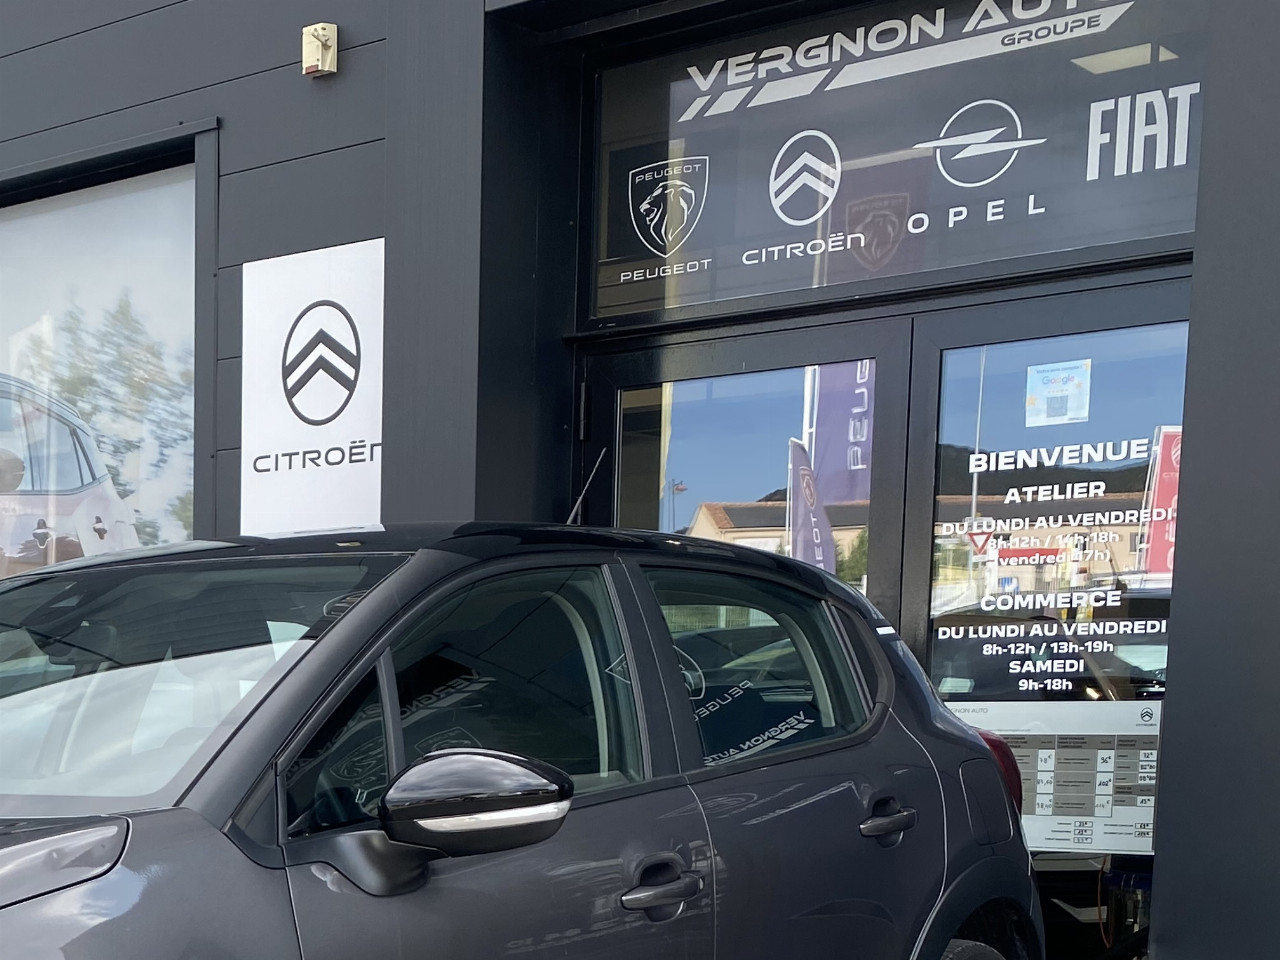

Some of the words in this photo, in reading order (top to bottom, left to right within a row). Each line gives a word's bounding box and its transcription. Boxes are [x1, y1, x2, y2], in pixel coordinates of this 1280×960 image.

[1001, 14, 1102, 47] GROUPE
[686, 8, 946, 92] VERGNON
[1086, 82, 1201, 181] FIAT
[635, 164, 702, 184] PEUGEOT
[907, 194, 1046, 234] OPEL
[620, 258, 713, 283] PEUGEOT
[969, 438, 1150, 473] BIENVENUE
[1004, 481, 1106, 504] ATELIER
[941, 522, 968, 535] DU
[972, 514, 1029, 533] LUNDI
[1034, 514, 1062, 530] AU
[1068, 507, 1176, 528] VENDREDI
[980, 590, 1122, 612] COMMERCE
[938, 626, 964, 640] DU
[968, 624, 1024, 639] LUNDI
[1029, 623, 1058, 637] AU
[1063, 620, 1167, 636] VENDREDI
[982, 643, 1035, 656] 8h-12h
[1050, 641, 1114, 654] 13h-19h
[1008, 659, 1085, 674] SAMEDI
[1018, 678, 1073, 691] 9h-18h
